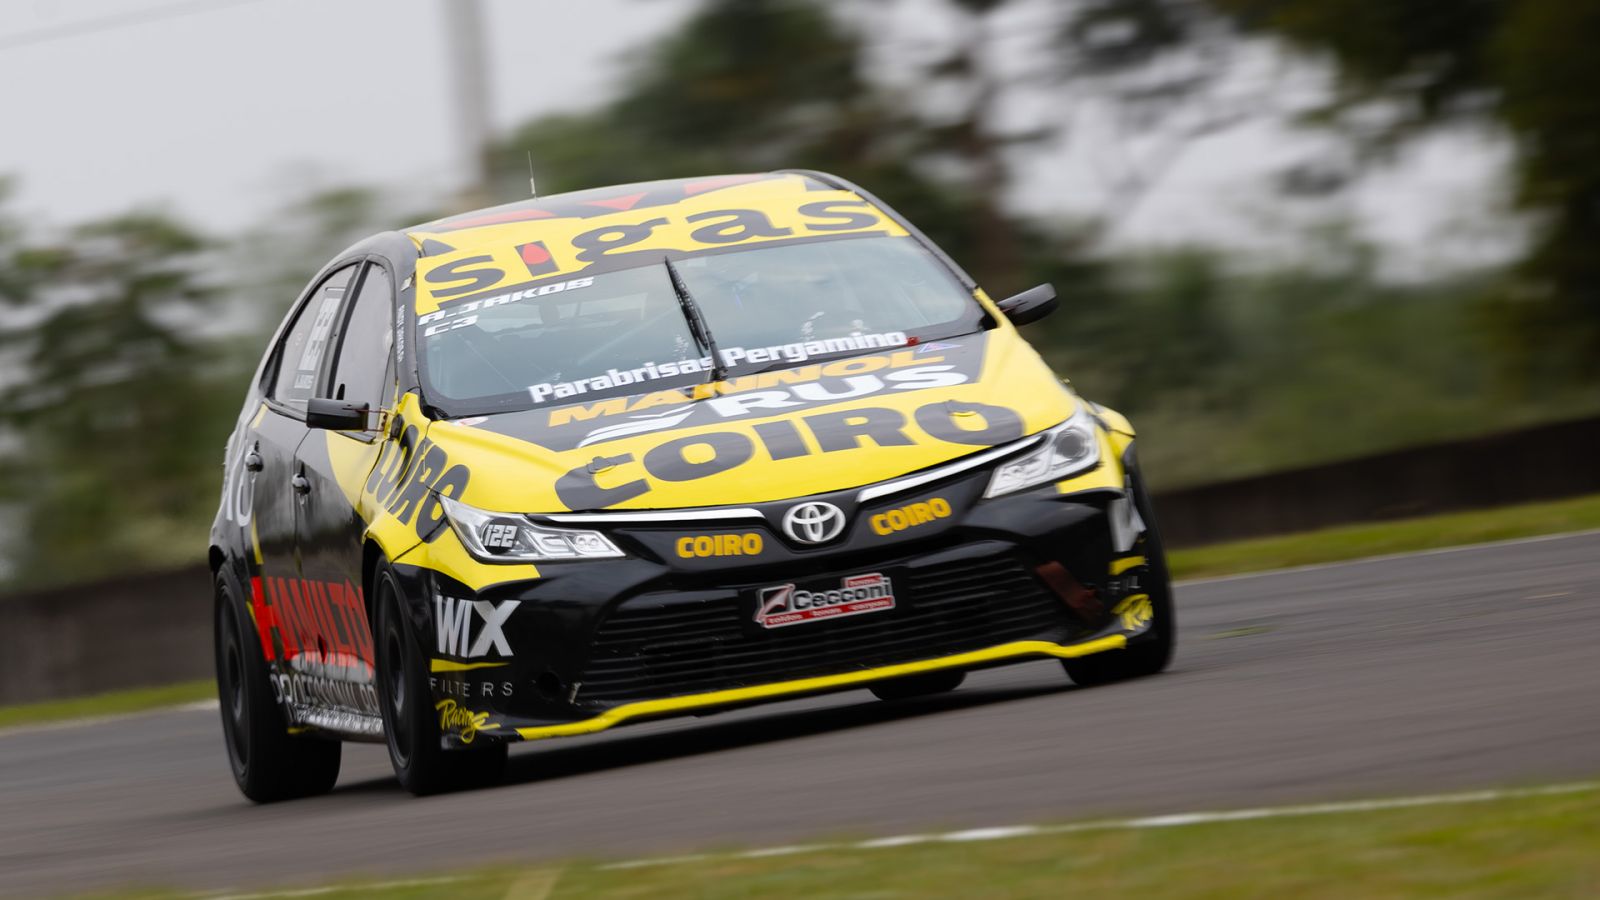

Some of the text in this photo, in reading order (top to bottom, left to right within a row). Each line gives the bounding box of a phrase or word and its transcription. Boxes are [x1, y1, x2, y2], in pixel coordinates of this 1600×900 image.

[424, 315, 479, 337] C3
[528, 331, 908, 403] Parabrisas Pergamino
[548, 350, 945, 427] MANNOL
[707, 365, 968, 418] RUS
[554, 401, 1025, 511] COIRO
[484, 524, 518, 548] 122
[870, 497, 952, 536] COIRO
[676, 533, 763, 558] COIRO
[792, 577, 894, 610] Cecconi
[435, 595, 522, 658] WIX
[428, 677, 513, 697] FILTERS
[435, 699, 501, 744] Racing
